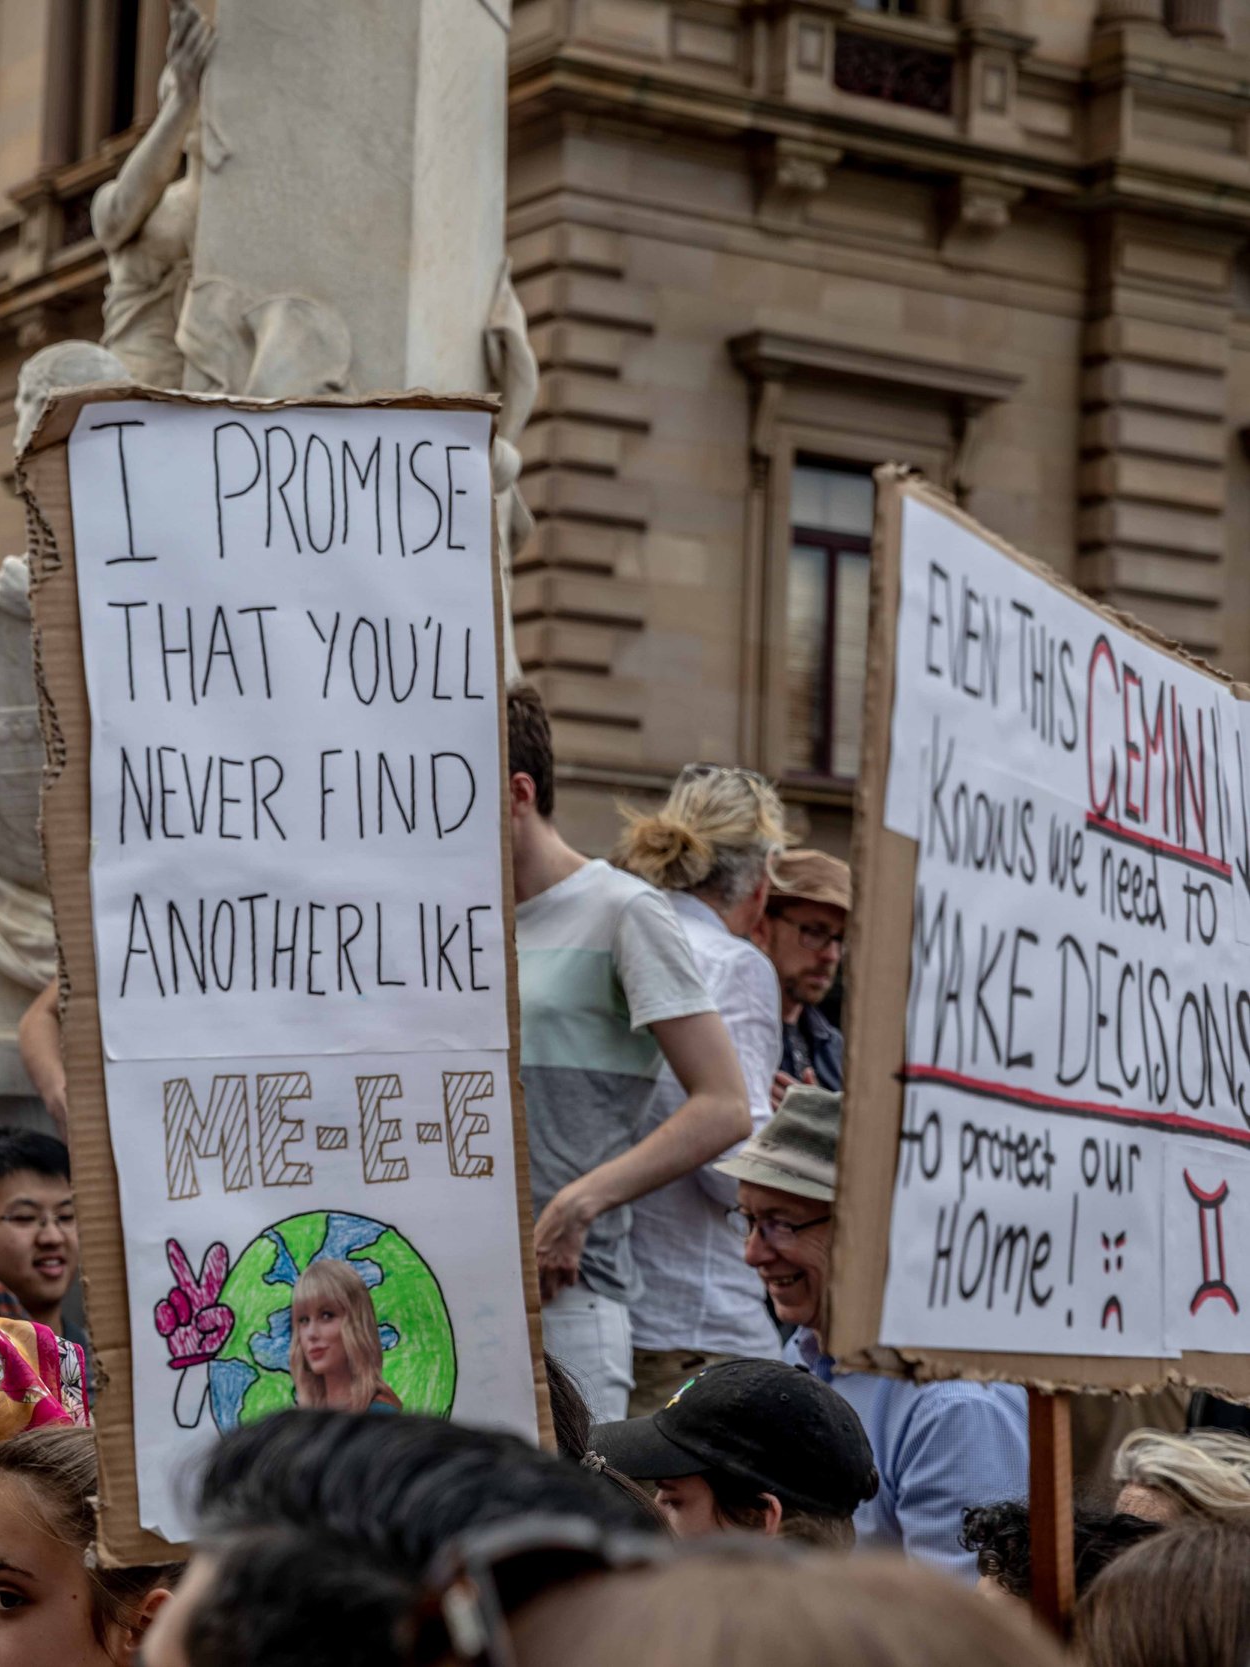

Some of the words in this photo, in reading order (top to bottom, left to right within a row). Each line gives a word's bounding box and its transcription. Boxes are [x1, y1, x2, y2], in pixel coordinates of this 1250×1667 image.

[90, 421, 158, 565] I
[213, 421, 471, 559] PROMISE
[107, 602, 277, 706] THAT
[306, 610, 484, 706] YOU'LL
[925, 559, 1002, 708] EVEN
[1011, 600, 1079, 753] THIS
[1087, 633, 1227, 867] GEMINI
[119, 746, 287, 845] NEVER
[320, 749, 476, 839] FIND
[1050, 813, 1088, 898] we
[1100, 845, 1167, 932] need
[1183, 872, 1218, 946] to
[906, 886, 1040, 1072] MAKE
[163, 1071, 495, 1200] ME-E-E
[900, 1091, 943, 1188] to
[960, 1121, 1054, 1202] protect
[1081, 1138, 1142, 1196] our
